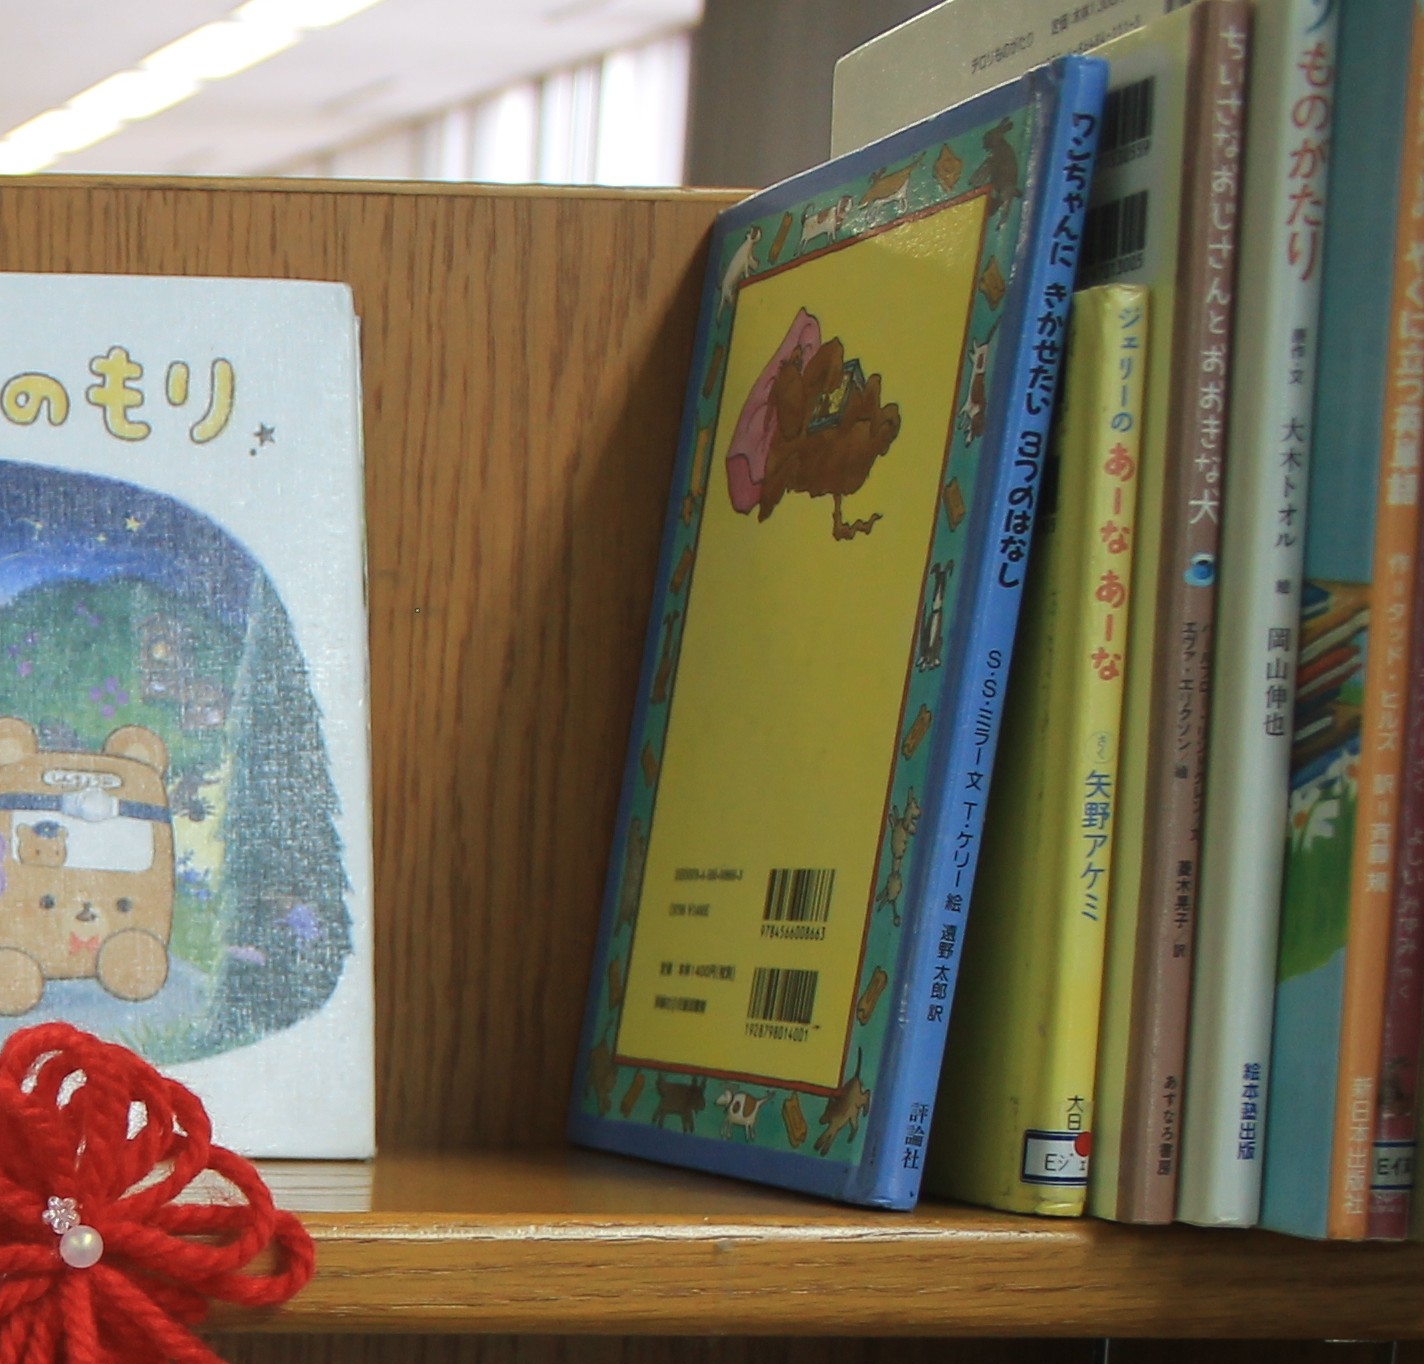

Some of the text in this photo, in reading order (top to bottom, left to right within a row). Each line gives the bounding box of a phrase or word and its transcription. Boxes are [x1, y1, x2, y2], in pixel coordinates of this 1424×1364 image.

[1049, 112, 1096, 268] ワンちゃんに
[1024, 280, 1067, 416] きかせたい
[1109, 306, 1141, 434] ジェリーの
[1099, 441, 1137, 555] あーな
[1275, 417, 1305, 549] 大木トオル
[1090, 569, 1128, 681] あーな
[1263, 627, 1291, 738] 岡山伸也
[1080, 770, 1113, 923] 矢野アケミ
[901, 1101, 931, 1171] 評論社
[1157, 1074, 1179, 1176] あすなろ書房
